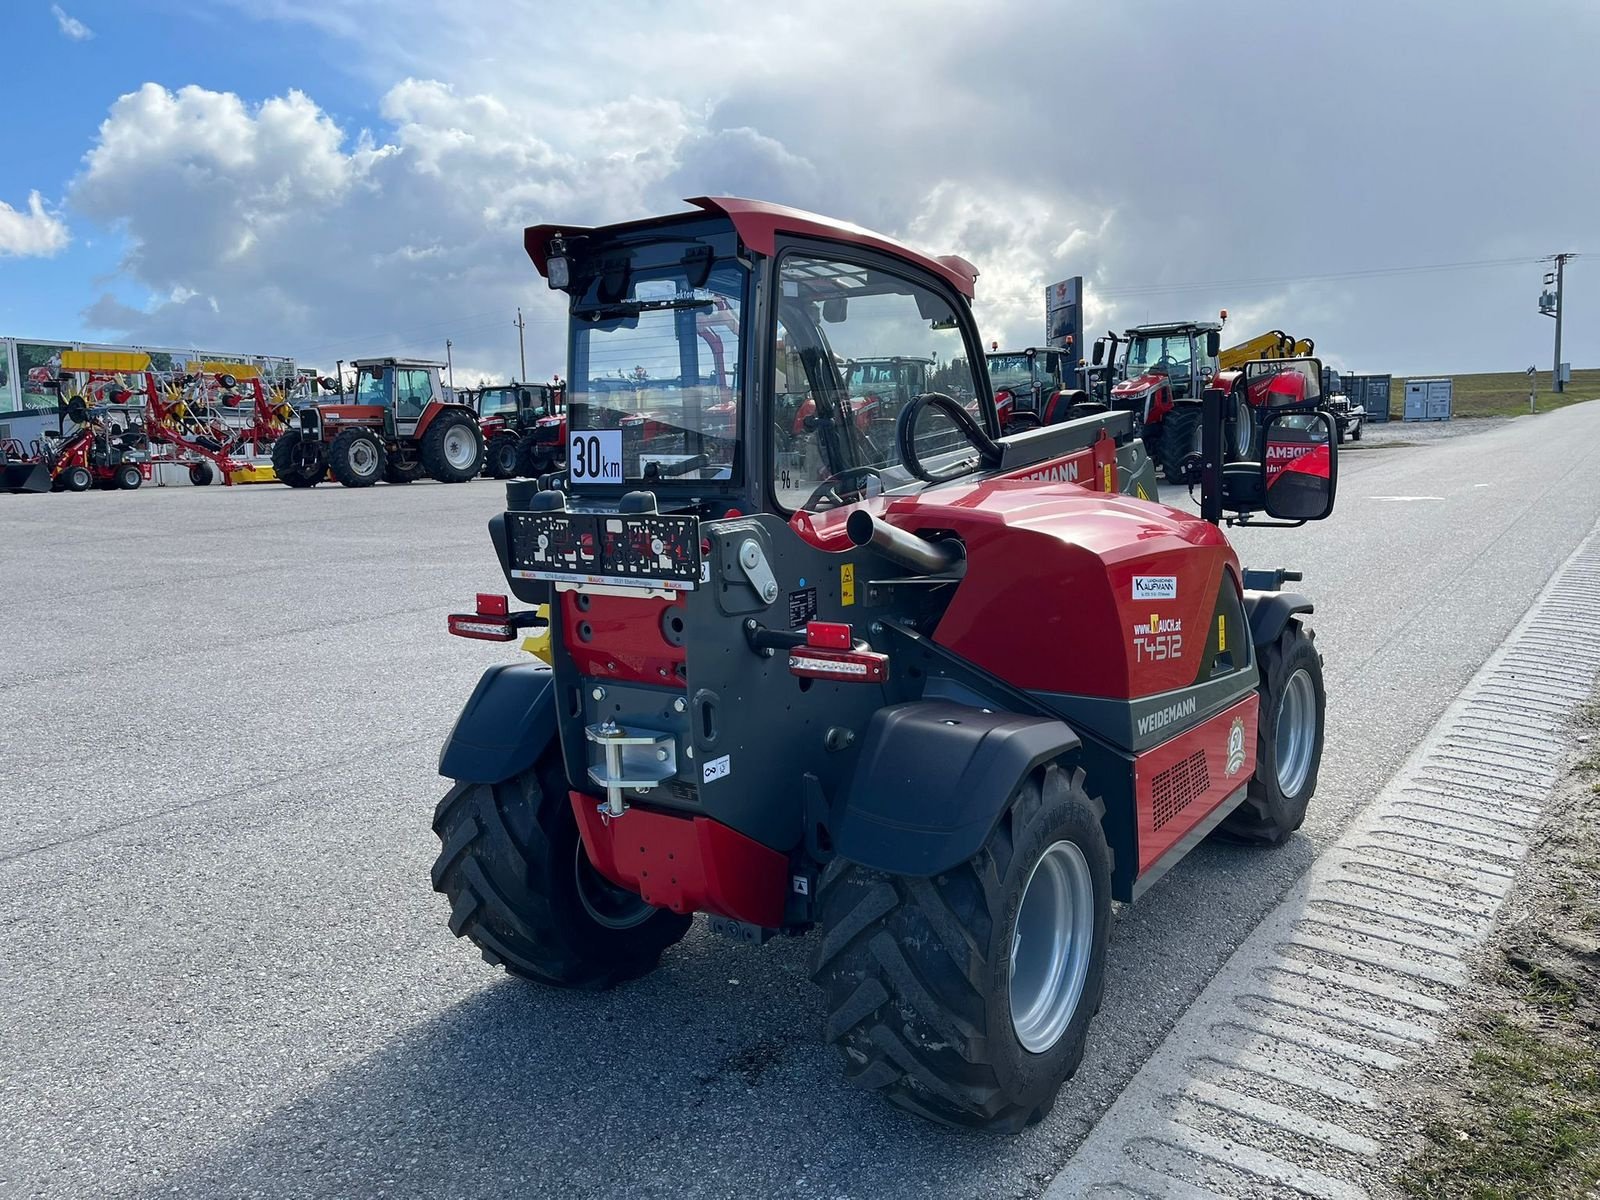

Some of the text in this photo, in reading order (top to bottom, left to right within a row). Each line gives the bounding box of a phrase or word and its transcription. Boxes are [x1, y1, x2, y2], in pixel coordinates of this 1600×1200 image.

[573, 436, 620, 478] 30 km
[781, 470, 791, 489] 96
[1135, 578, 1174, 591] KAUFMANN
[1134, 635, 1182, 663] T4512
[1137, 696, 1196, 736] WEIDEMANN
